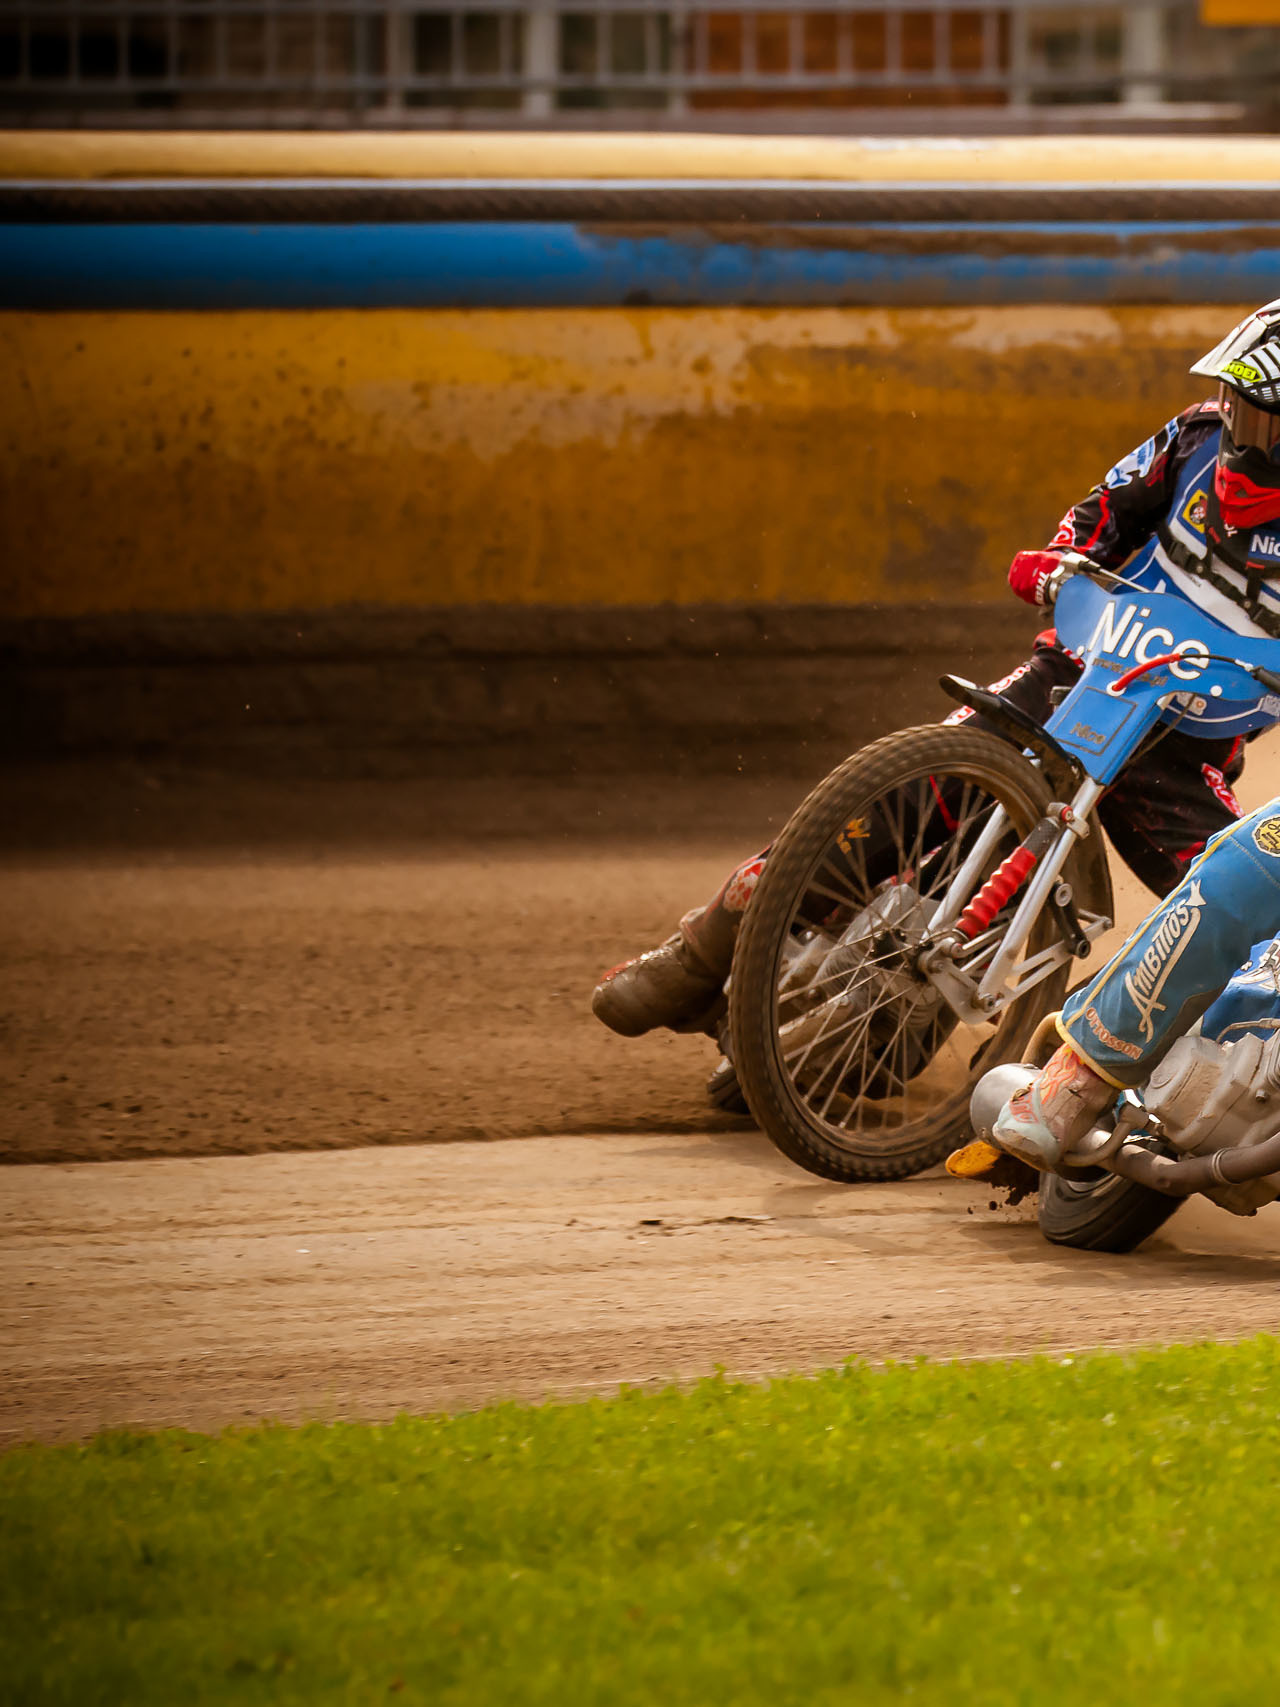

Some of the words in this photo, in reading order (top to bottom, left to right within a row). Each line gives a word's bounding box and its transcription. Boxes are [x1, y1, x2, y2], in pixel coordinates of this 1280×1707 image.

[1087, 600, 1211, 681] Nice
[1068, 722, 1107, 745] Nice
[1085, 1007, 1144, 1060] OTTOSSON
